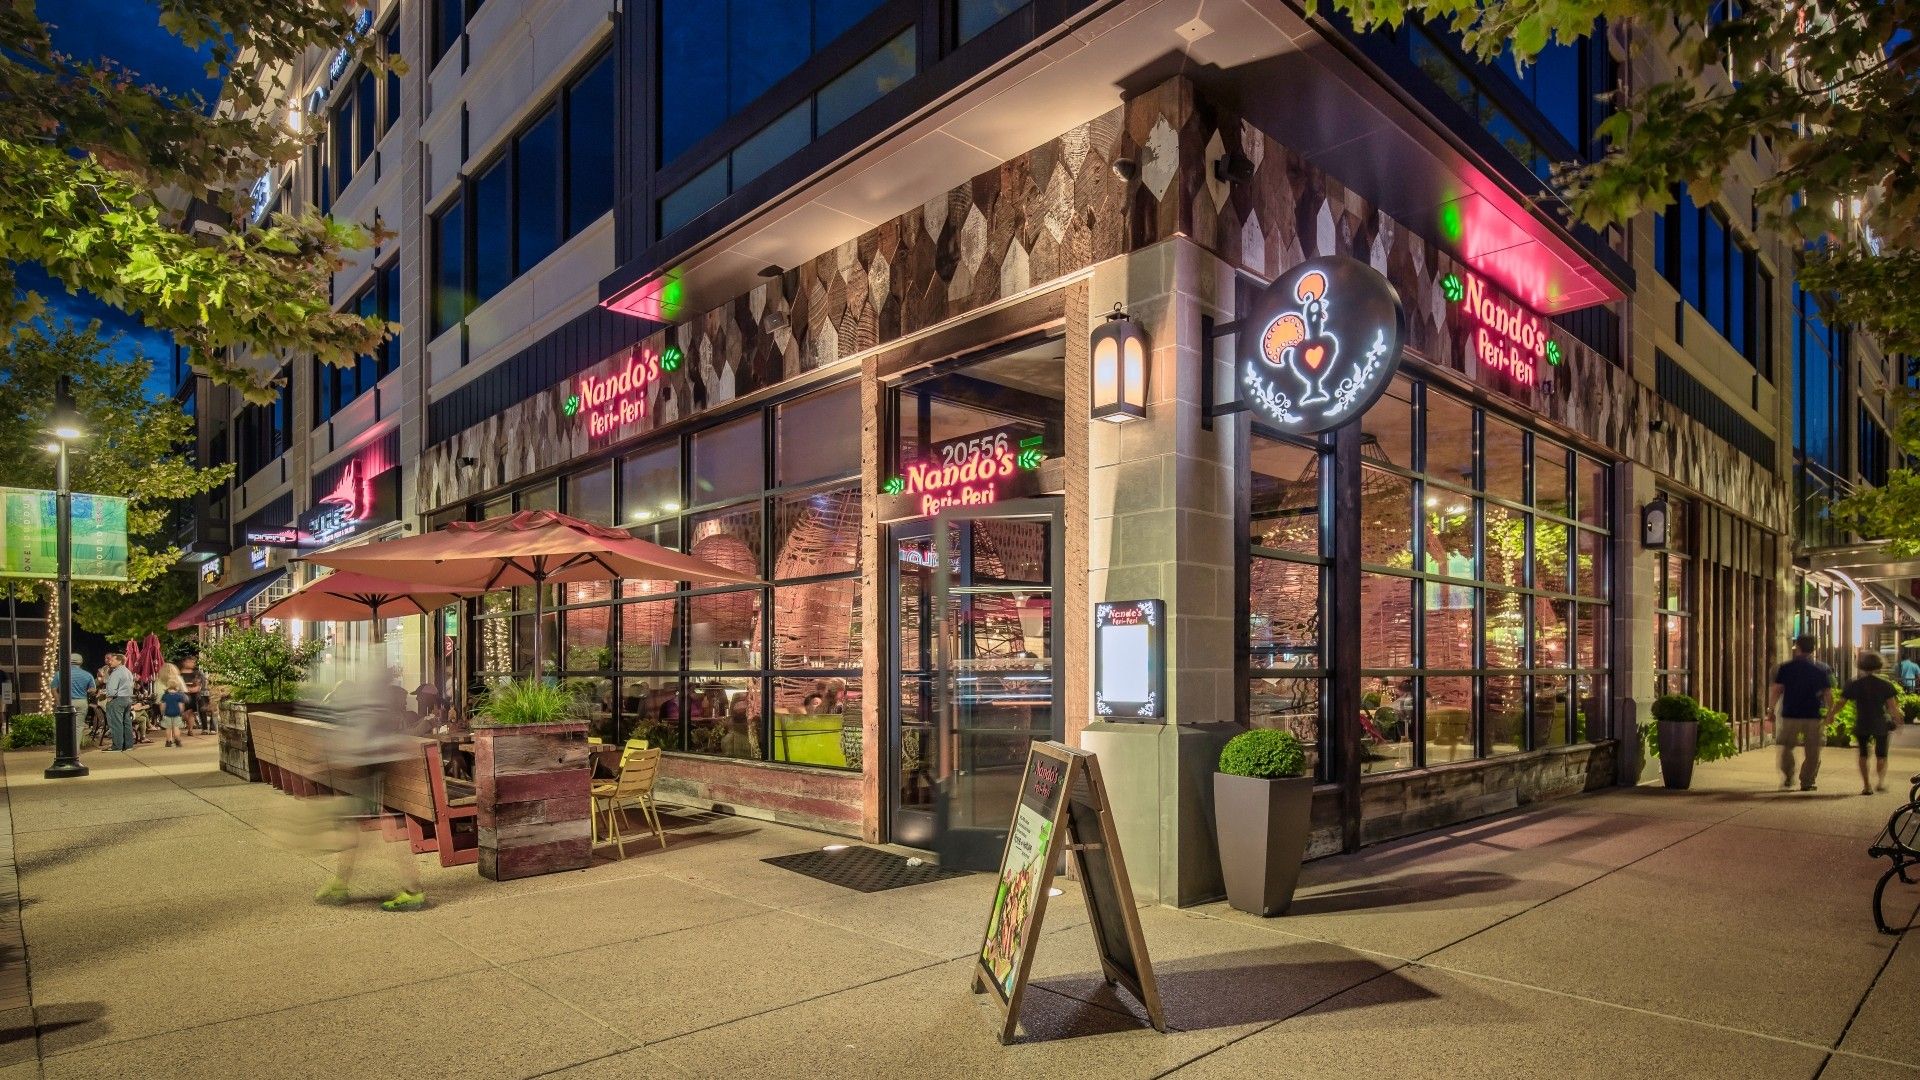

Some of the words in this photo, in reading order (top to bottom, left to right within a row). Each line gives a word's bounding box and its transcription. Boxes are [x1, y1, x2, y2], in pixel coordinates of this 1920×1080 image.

[1463, 272, 1545, 357] Nando's
[1479, 328, 1533, 386] Peri-Peri
[579, 349, 659, 413] Nando's
[591, 391, 645, 437] Peri-Peri
[905, 446, 1014, 494] Nando's
[942, 432, 1009, 470] 20556
[922, 482, 994, 516] Peri-Peri
[1108, 608, 1142, 618] Nando's
